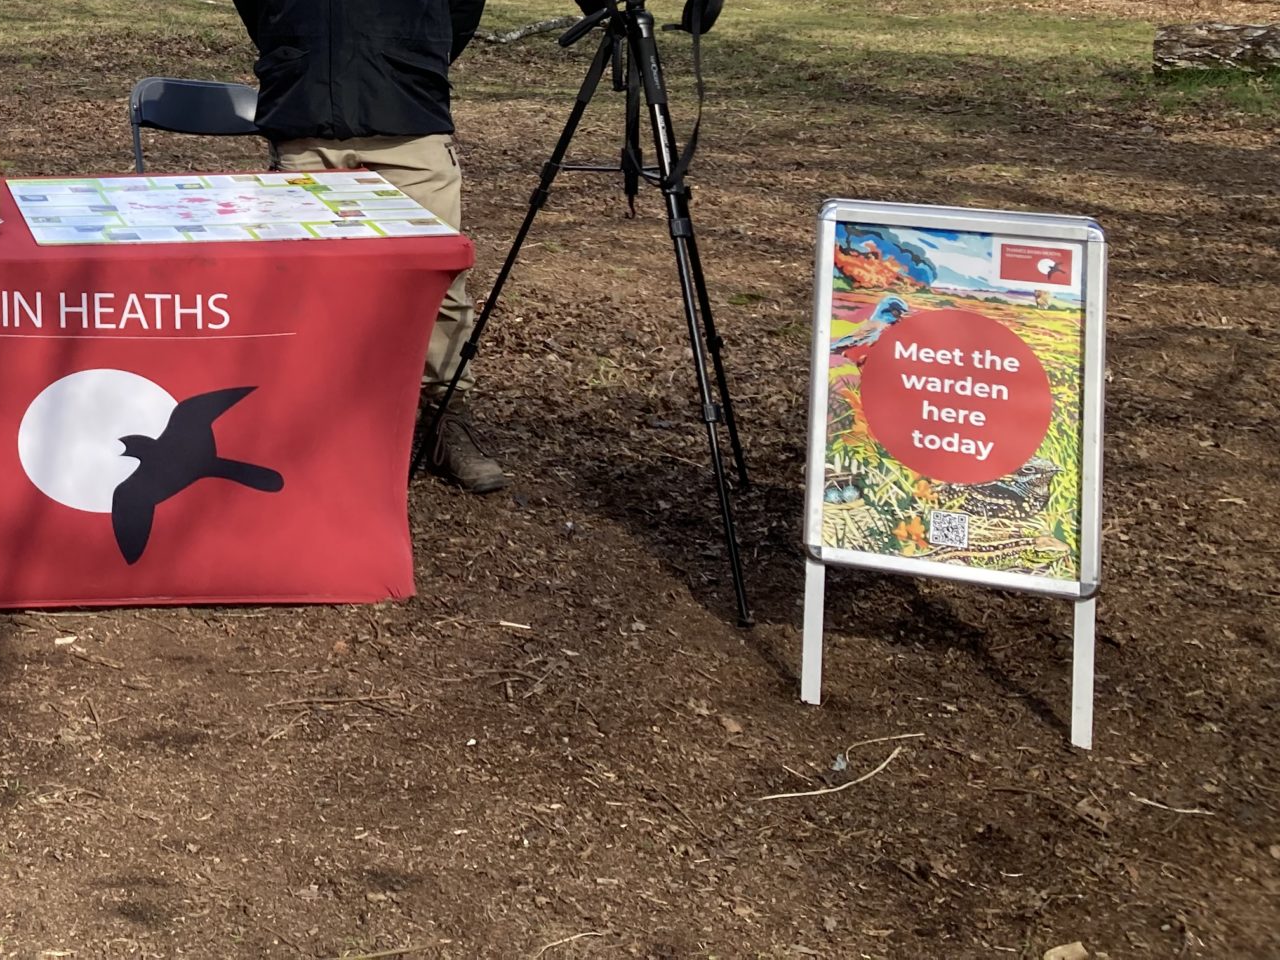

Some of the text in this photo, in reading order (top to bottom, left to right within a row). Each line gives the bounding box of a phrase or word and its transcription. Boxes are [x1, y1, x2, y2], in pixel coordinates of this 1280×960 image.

[59, 292, 231, 330] HEATHS
[894, 340, 1020, 373] Meet the
[901, 373, 1009, 401] warden
[921, 399, 987, 427] here
[911, 429, 995, 461] today
